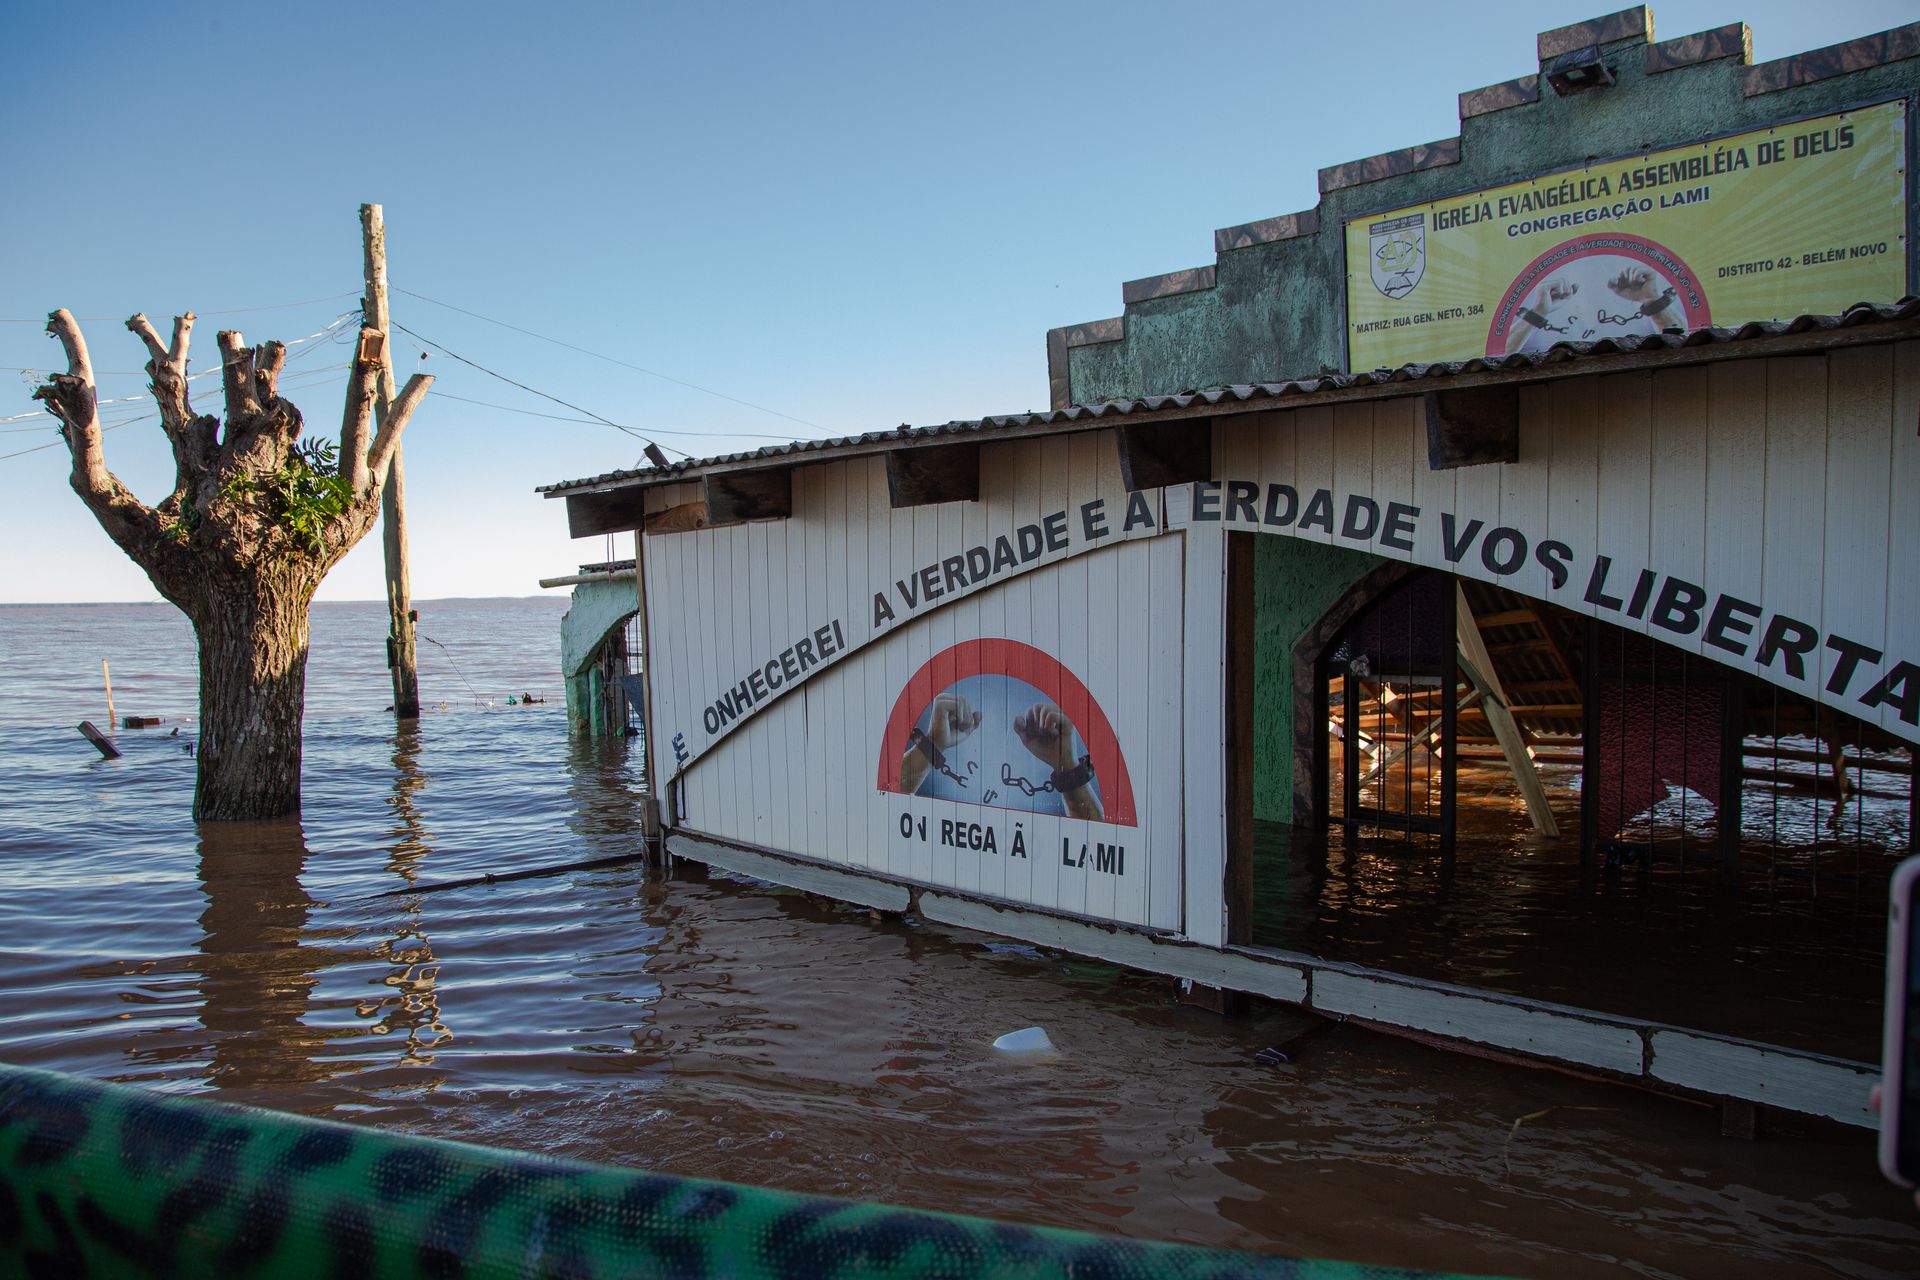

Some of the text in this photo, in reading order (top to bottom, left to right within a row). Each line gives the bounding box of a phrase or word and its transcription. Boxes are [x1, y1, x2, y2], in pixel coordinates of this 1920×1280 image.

[1432, 125, 1854, 232] IGREJA EVANGÉLICA ASSEMBLÉIA DE DEUS
[1507, 186, 1710, 237] CONGREGAÇÃO LAMI
[1534, 249, 1569, 273] VERDADE
[1579, 242, 1586, 250] A
[1585, 239, 1625, 248] VERDADE
[1627, 241, 1642, 252] VOS
[1718, 260, 1773, 278] DISTRITO
[1777, 257, 1792, 269] 42
[1803, 248, 1845, 266] BELÉM
[1850, 242, 1887, 259] NOVO
[1356, 304, 1484, 333] MATRIZ: RUA GEN. NETO, 384
[873, 591, 895, 628] A
[896, 510, 1068, 610] VERDADE
[1081, 498, 1109, 541] E
[1123, 490, 1155, 531] A
[1441, 512, 1574, 590] VOS
[1583, 554, 1920, 728] LIBERTA
